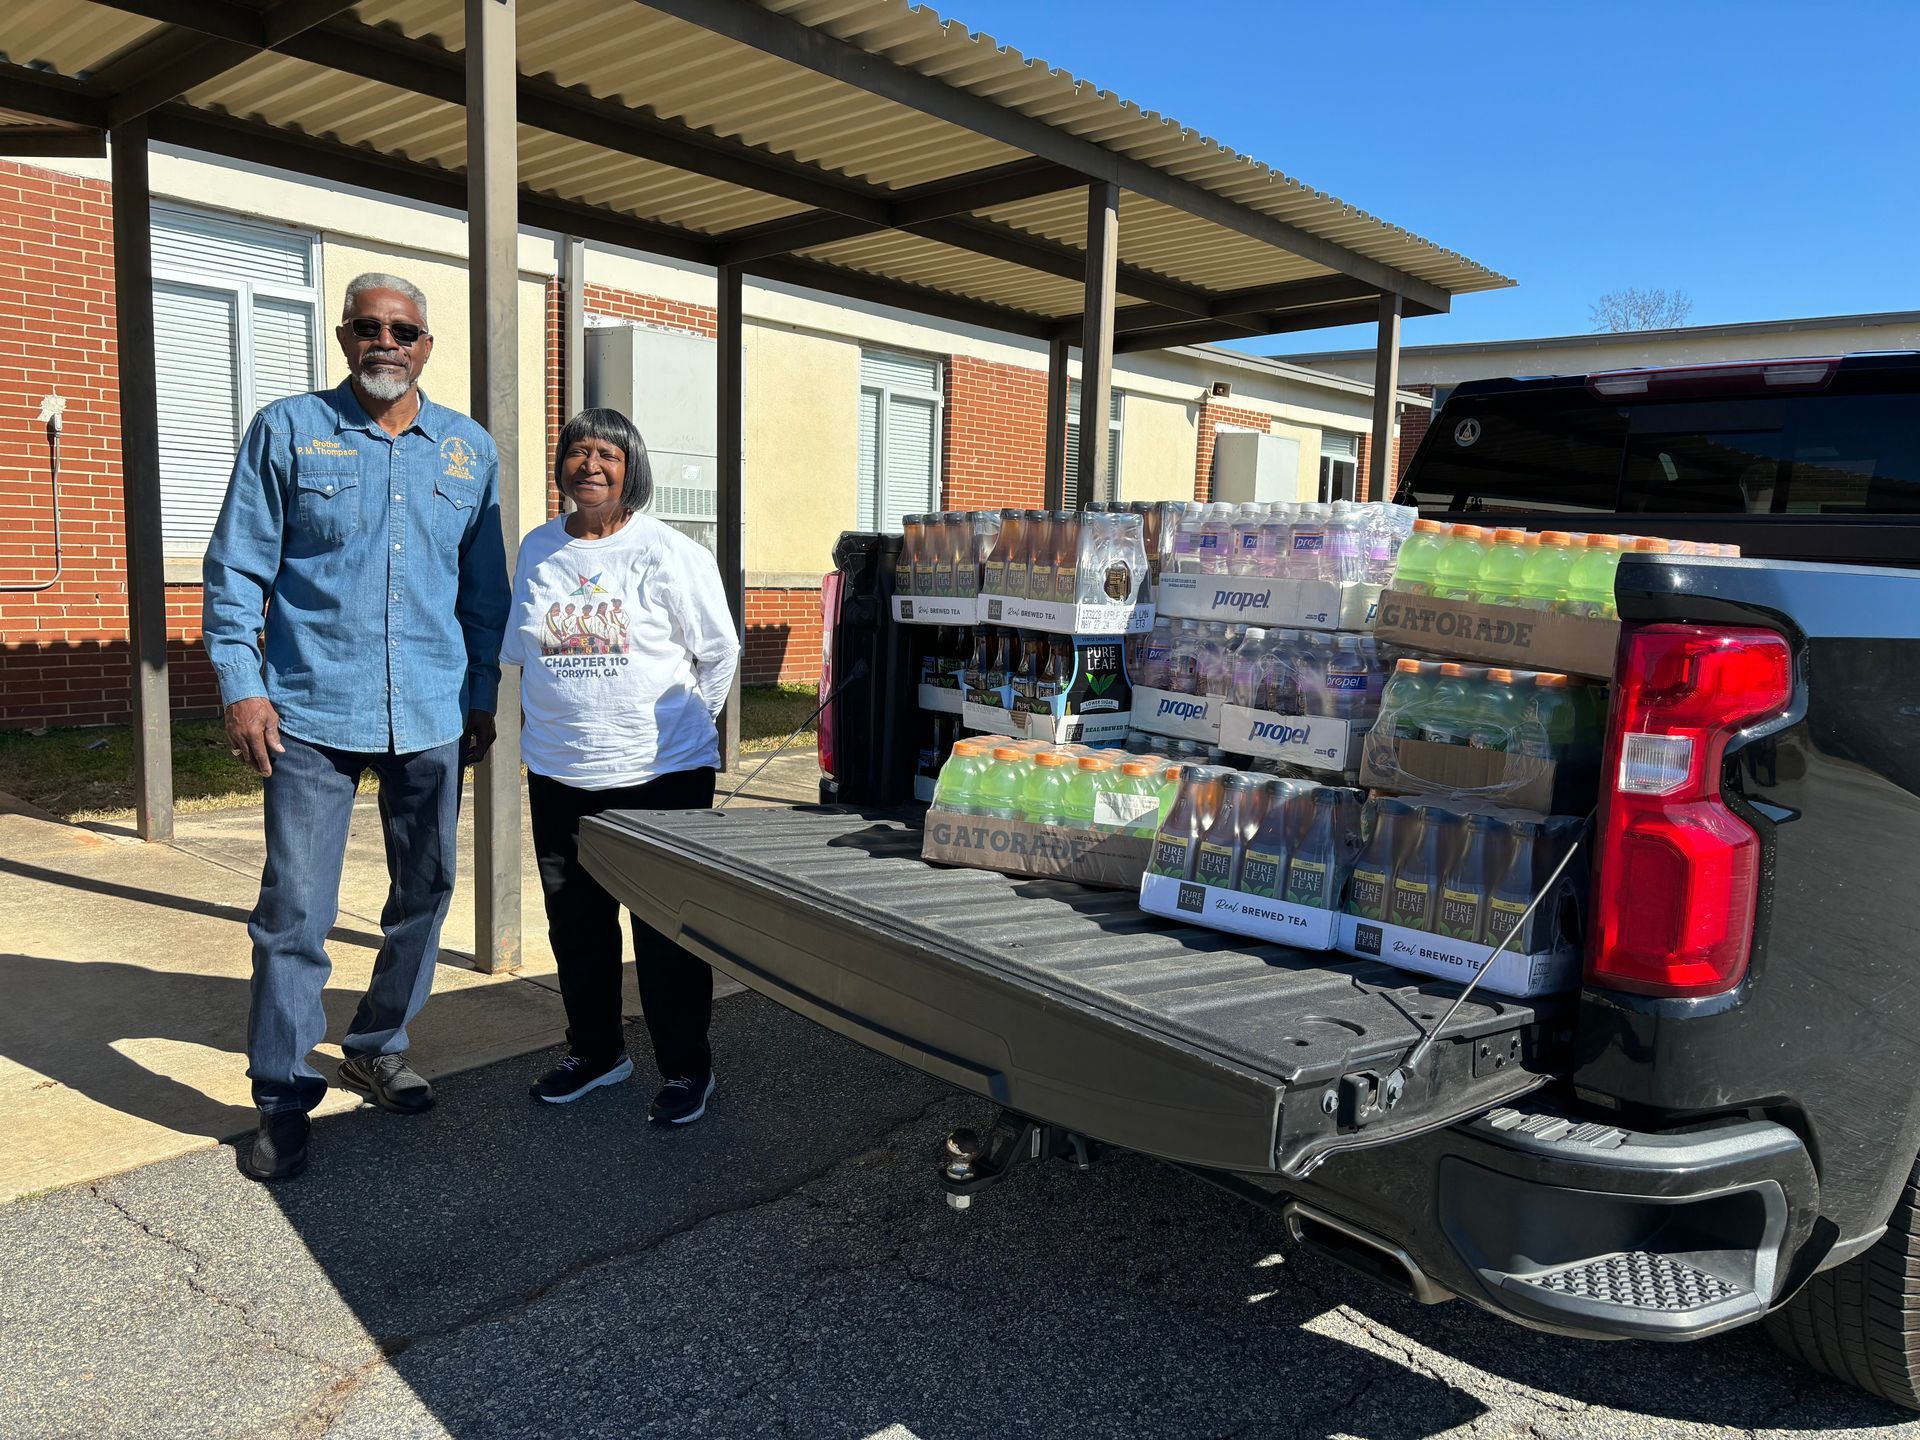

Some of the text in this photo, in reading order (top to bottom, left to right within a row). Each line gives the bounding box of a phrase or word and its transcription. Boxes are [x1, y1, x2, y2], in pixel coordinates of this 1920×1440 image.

[312, 439, 340, 449] Brother
[316, 447, 358, 456] Thompson
[1211, 589, 1270, 611] propel
[930, 607, 950, 615] BREWED
[1021, 609, 1043, 619] BREWED
[1382, 604, 1533, 648] GATORADE
[1087, 646, 1116, 658] PURE
[544, 657, 629, 668] CHAPTER 110
[556, 668, 618, 679] FORSYTH, GA
[1157, 698, 1206, 721] propel
[1248, 720, 1310, 745] propel
[932, 823, 1086, 862] GATORADE
[1159, 843, 1184, 855] PURE
[1202, 853, 1229, 865] PURE
[1247, 861, 1274, 874] PURE
[1292, 870, 1321, 882] PURE
[1355, 881, 1381, 894] PURE
[1181, 890, 1202, 900] PURE
[1397, 890, 1423, 903] PURE
[1215, 899, 1308, 927] Real BREWED TEA
[1446, 901, 1473, 914] PURE
[1358, 930, 1380, 941] PURE
[1392, 940, 1417, 955] Real
[1419, 948, 1463, 966] BREWED
